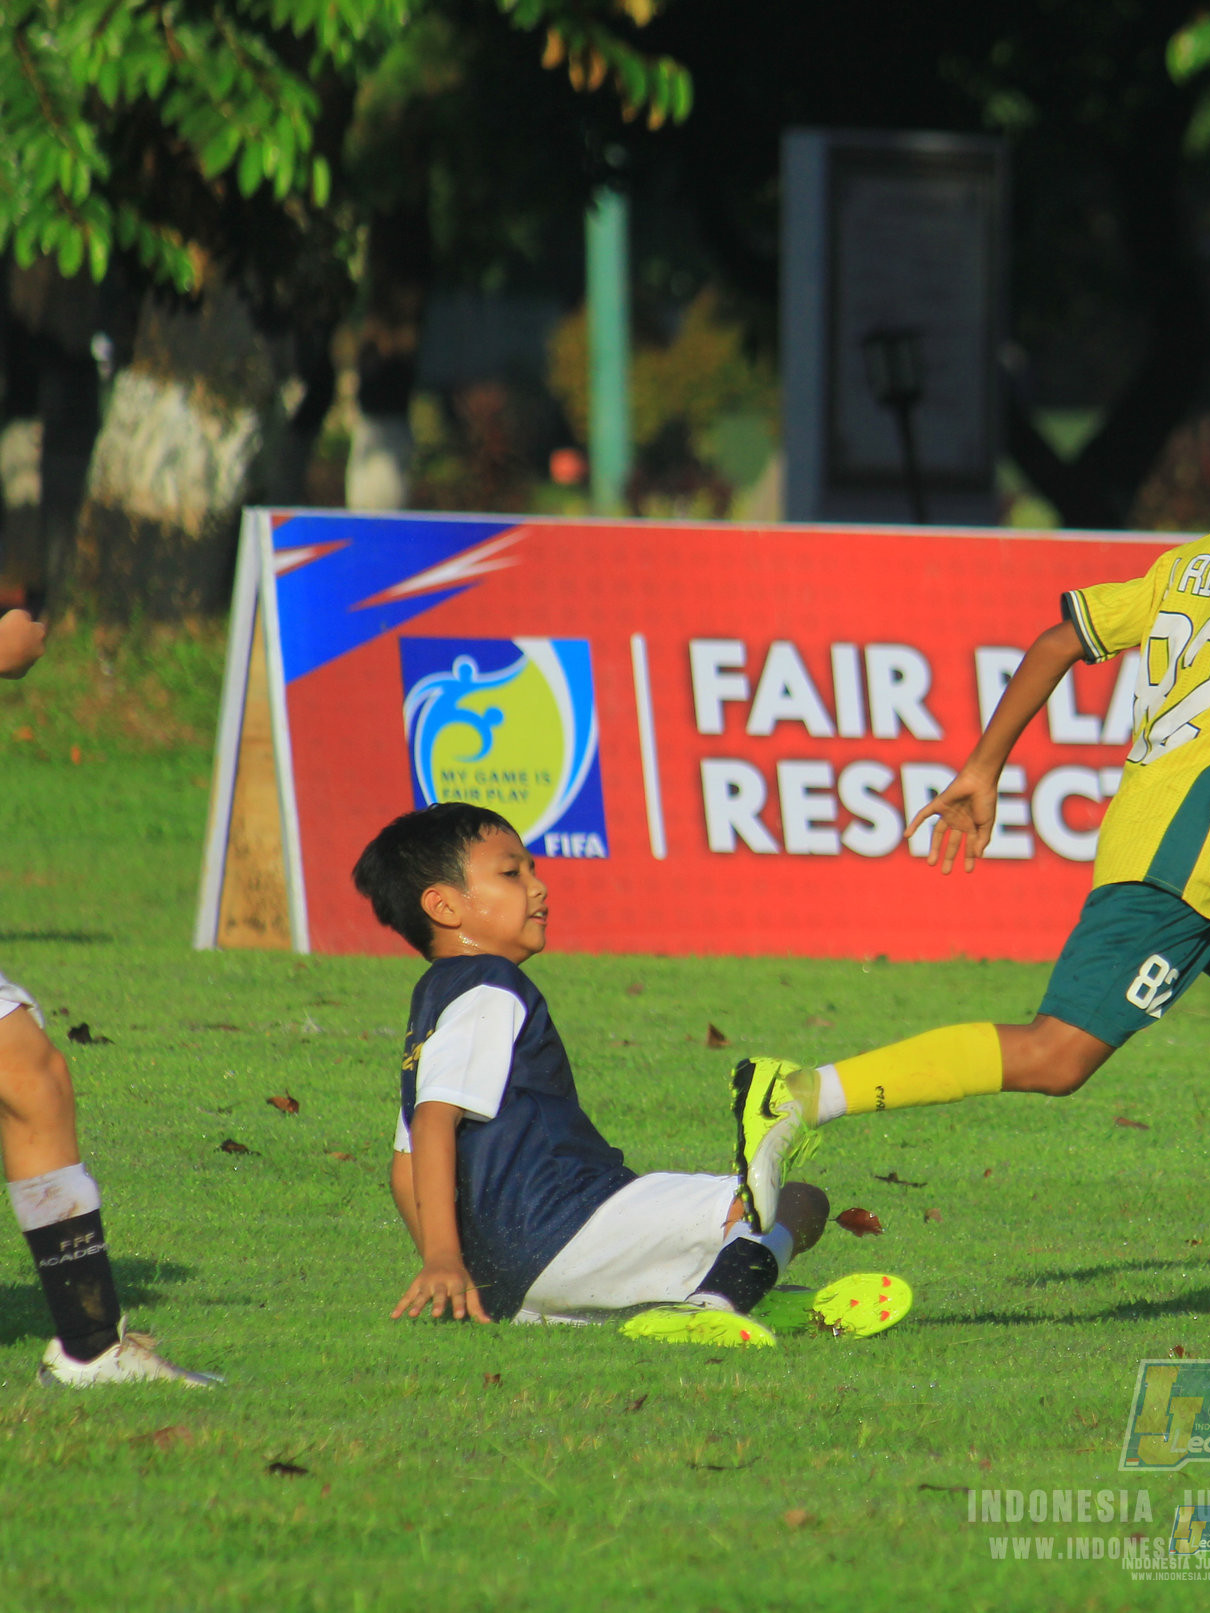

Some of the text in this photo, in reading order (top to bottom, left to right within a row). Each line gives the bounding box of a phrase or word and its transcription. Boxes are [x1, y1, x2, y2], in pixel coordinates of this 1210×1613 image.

[688, 637, 944, 741] FAIR
[974, 644, 1141, 746] PL
[440, 770, 551, 784] MY GAME IS
[442, 788, 529, 802] FAIR PLAY
[699, 757, 1124, 862] RESPEC
[544, 832, 607, 858] FIFA
[1126, 953, 1180, 1019] 82
[39, 1242, 109, 1268] ACADEM
